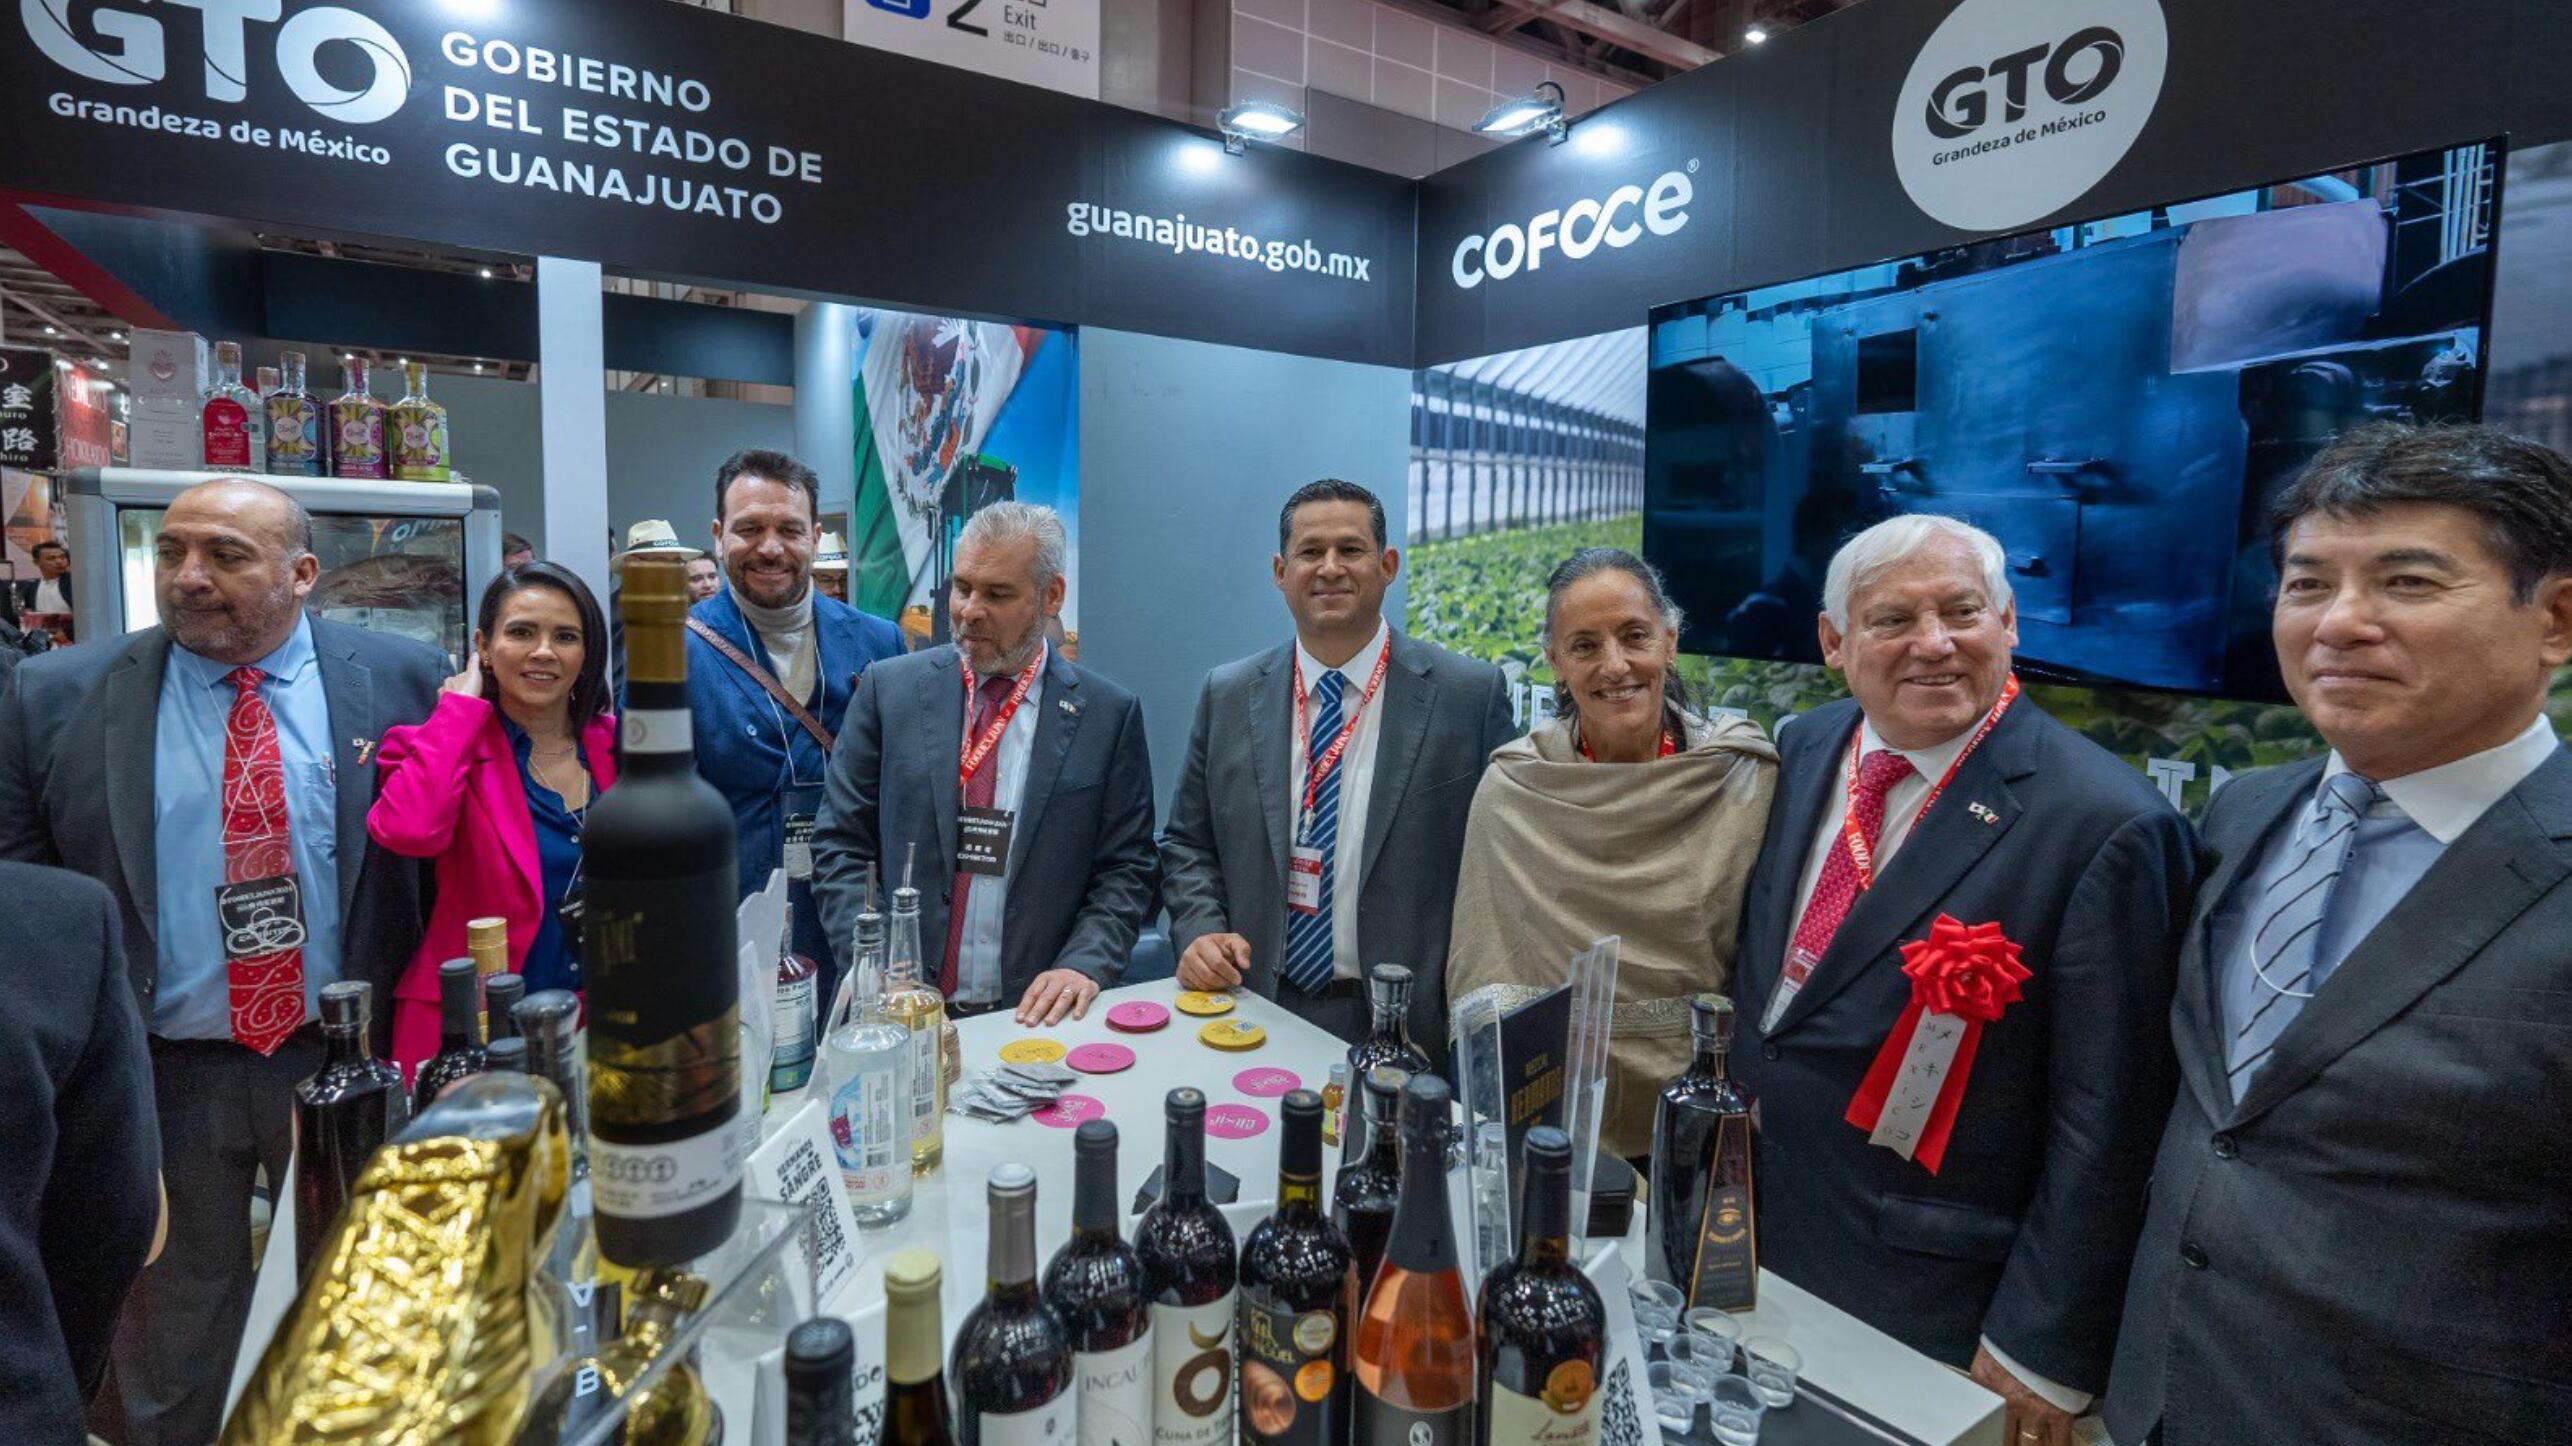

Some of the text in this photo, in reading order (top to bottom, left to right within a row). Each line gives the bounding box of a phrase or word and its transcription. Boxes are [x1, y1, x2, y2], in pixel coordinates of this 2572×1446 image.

[1003, 31, 1026, 46] 出口
[1038, 40, 1060, 55] 出口
[1004, 5, 1037, 30] Exit
[21, 0, 411, 124] GTO
[441, 31, 711, 112] GOBIERNO
[1925, 26, 2124, 139] GTO
[48, 92, 391, 165] Grandeza de México
[444, 86, 822, 183] DEL ESTADO DE
[1932, 110, 2106, 166] Grandeza de México
[446, 142, 784, 224] GUANAJUATO
[1067, 203, 1370, 281] guanajuato.gob.mx
[776, 1138, 814, 1177] HERMANOS
[779, 1153, 823, 1204] SANGRE
